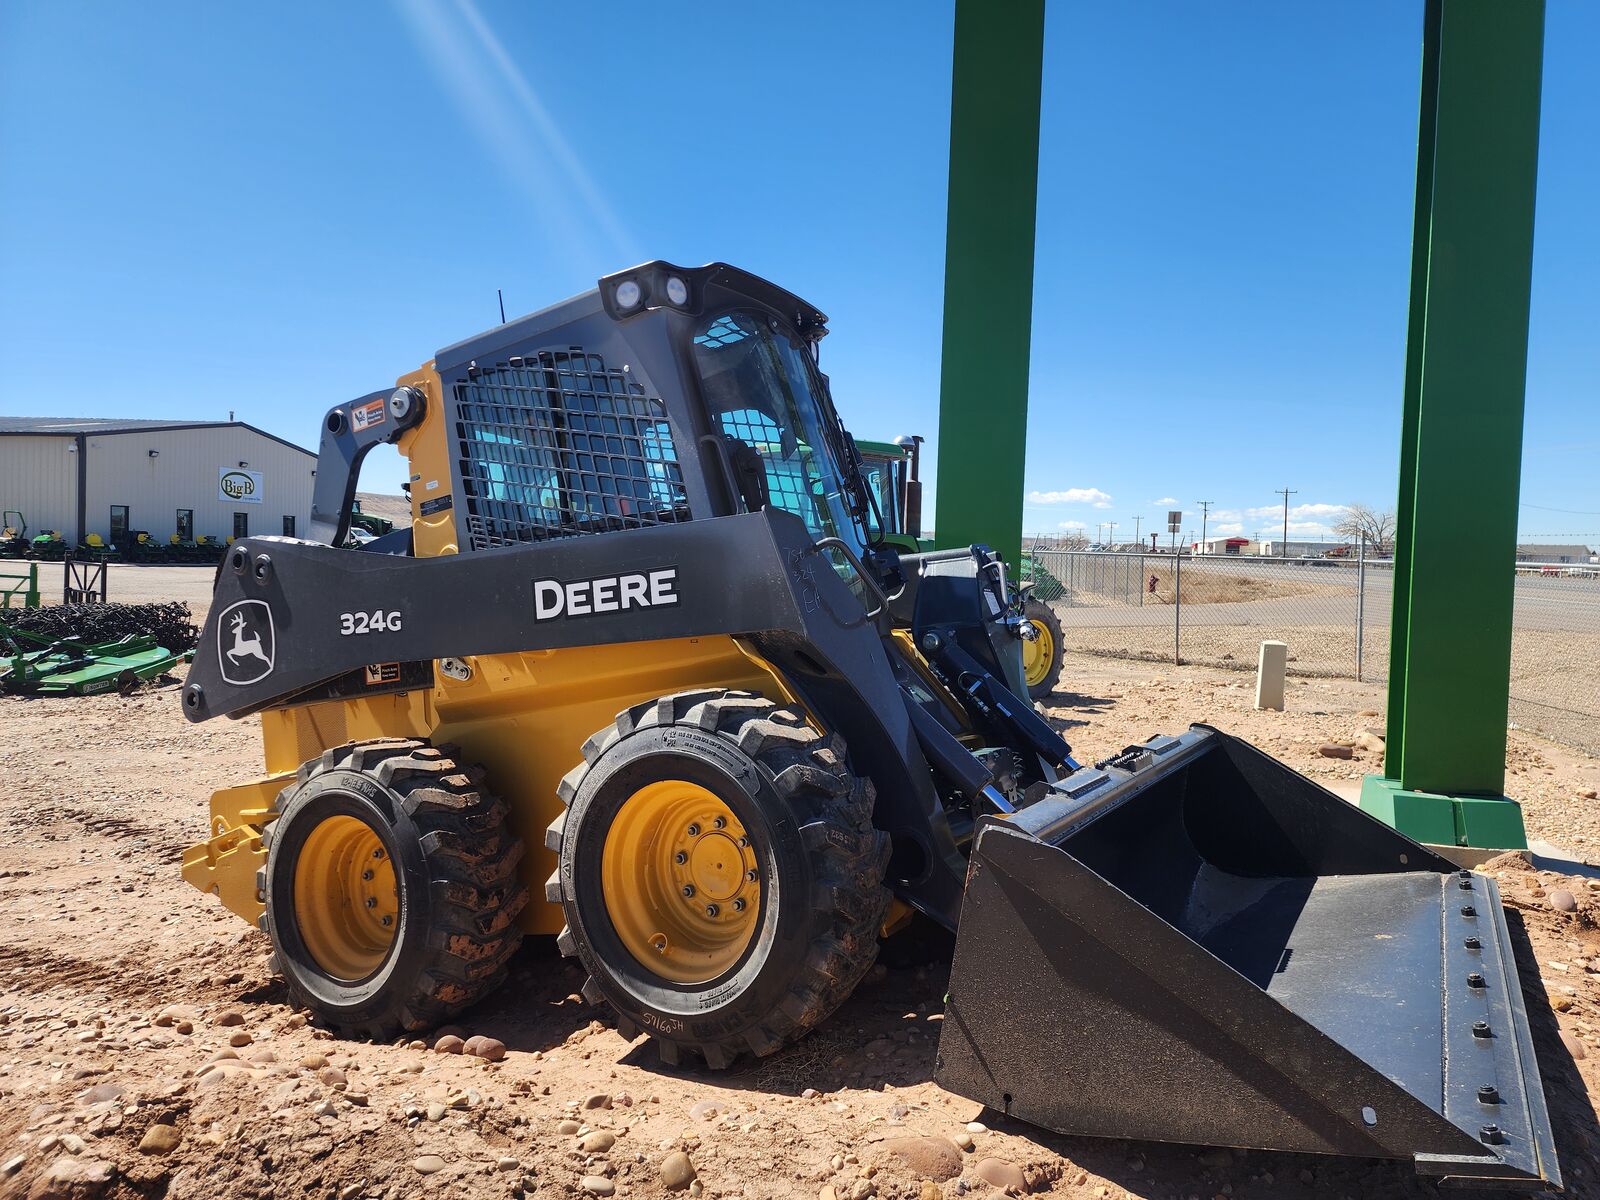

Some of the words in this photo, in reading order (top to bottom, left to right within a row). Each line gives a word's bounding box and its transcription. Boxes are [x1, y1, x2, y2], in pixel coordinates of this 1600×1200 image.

[225, 479, 243, 496] Big
[244, 481, 252, 494] B
[534, 569, 678, 620] DEERE
[340, 610, 402, 635] 324G
